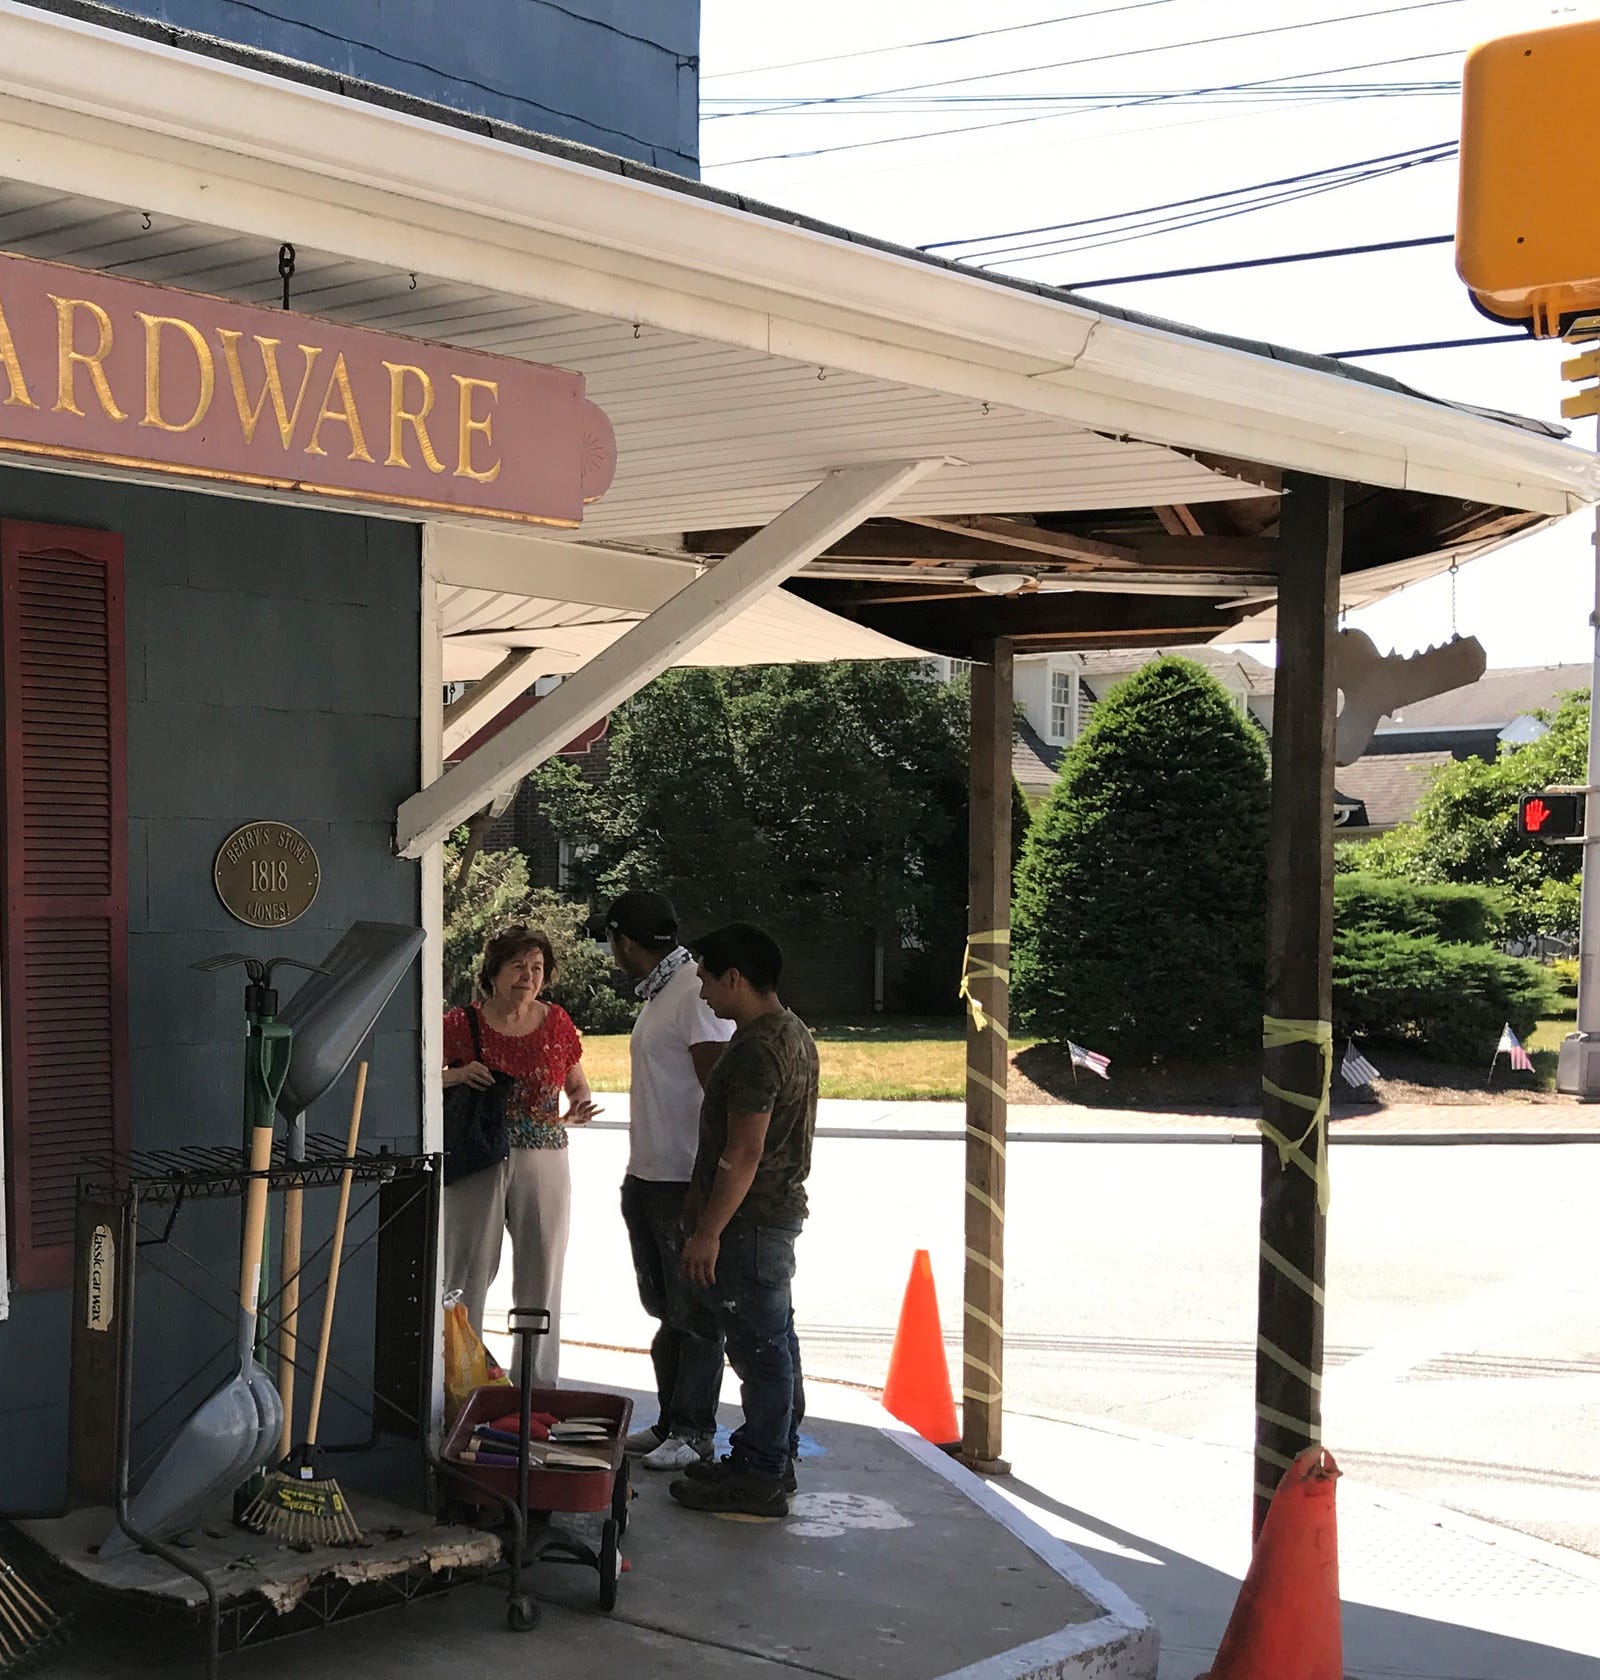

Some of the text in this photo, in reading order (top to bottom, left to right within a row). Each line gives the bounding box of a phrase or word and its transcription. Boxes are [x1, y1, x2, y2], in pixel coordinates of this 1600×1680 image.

[226, 828, 310, 865] BERRY'S STORE
[251, 860, 289, 892] 1818
[92, 1271, 102, 1292] car
[91, 1293, 102, 1322] wax
